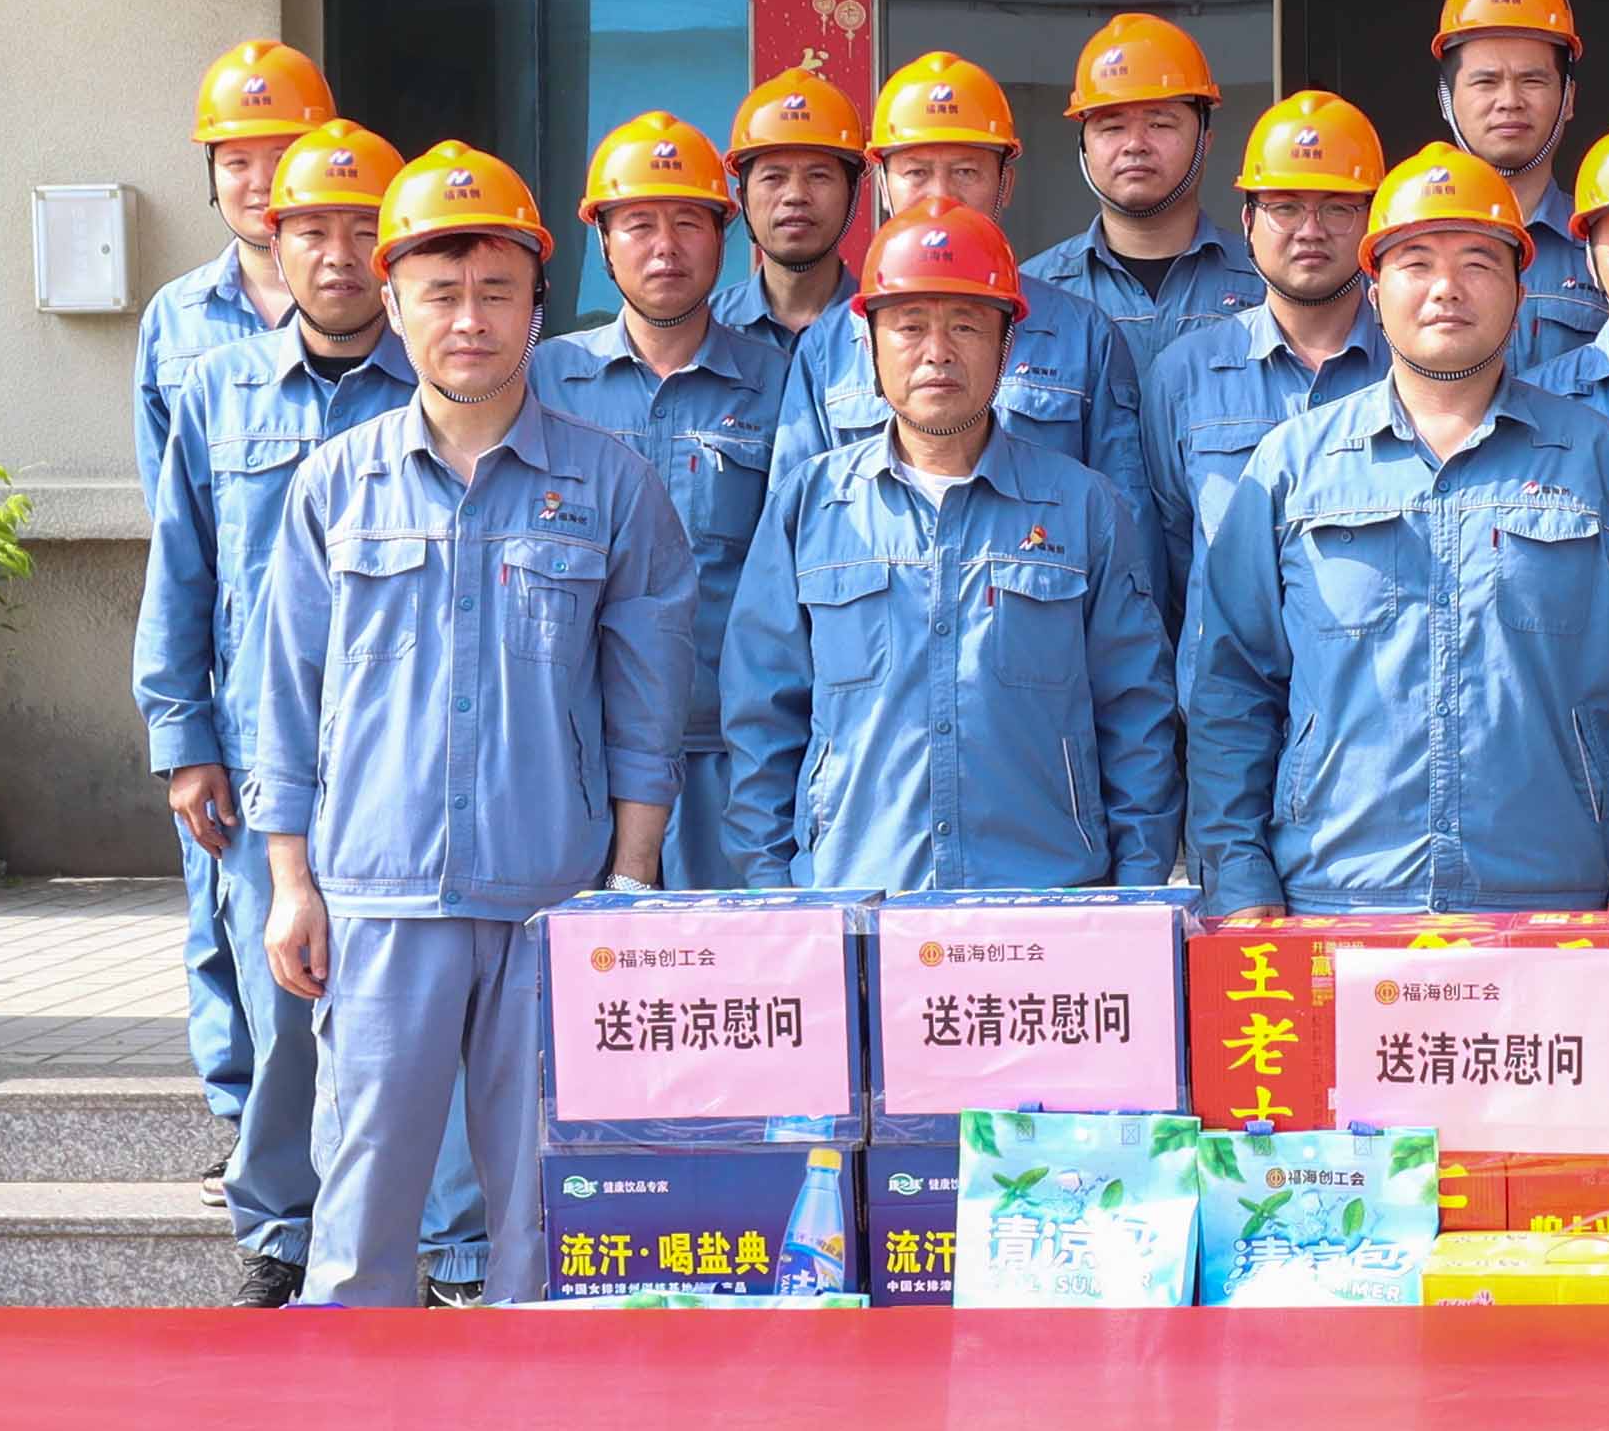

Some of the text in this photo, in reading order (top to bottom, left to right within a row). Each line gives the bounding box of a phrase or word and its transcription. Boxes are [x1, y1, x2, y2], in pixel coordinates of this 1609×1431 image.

[619, 948, 716, 969] 福海创工会
[947, 943, 1045, 965] 福海创工会
[1402, 982, 1500, 1003] 福海创工会
[594, 996, 803, 1053] 送清凉慰问
[922, 992, 1131, 1048] 送清凉慰问
[1376, 1032, 1584, 1087] 送清凉慰问
[1288, 1169, 1366, 1188] 福海创工会
